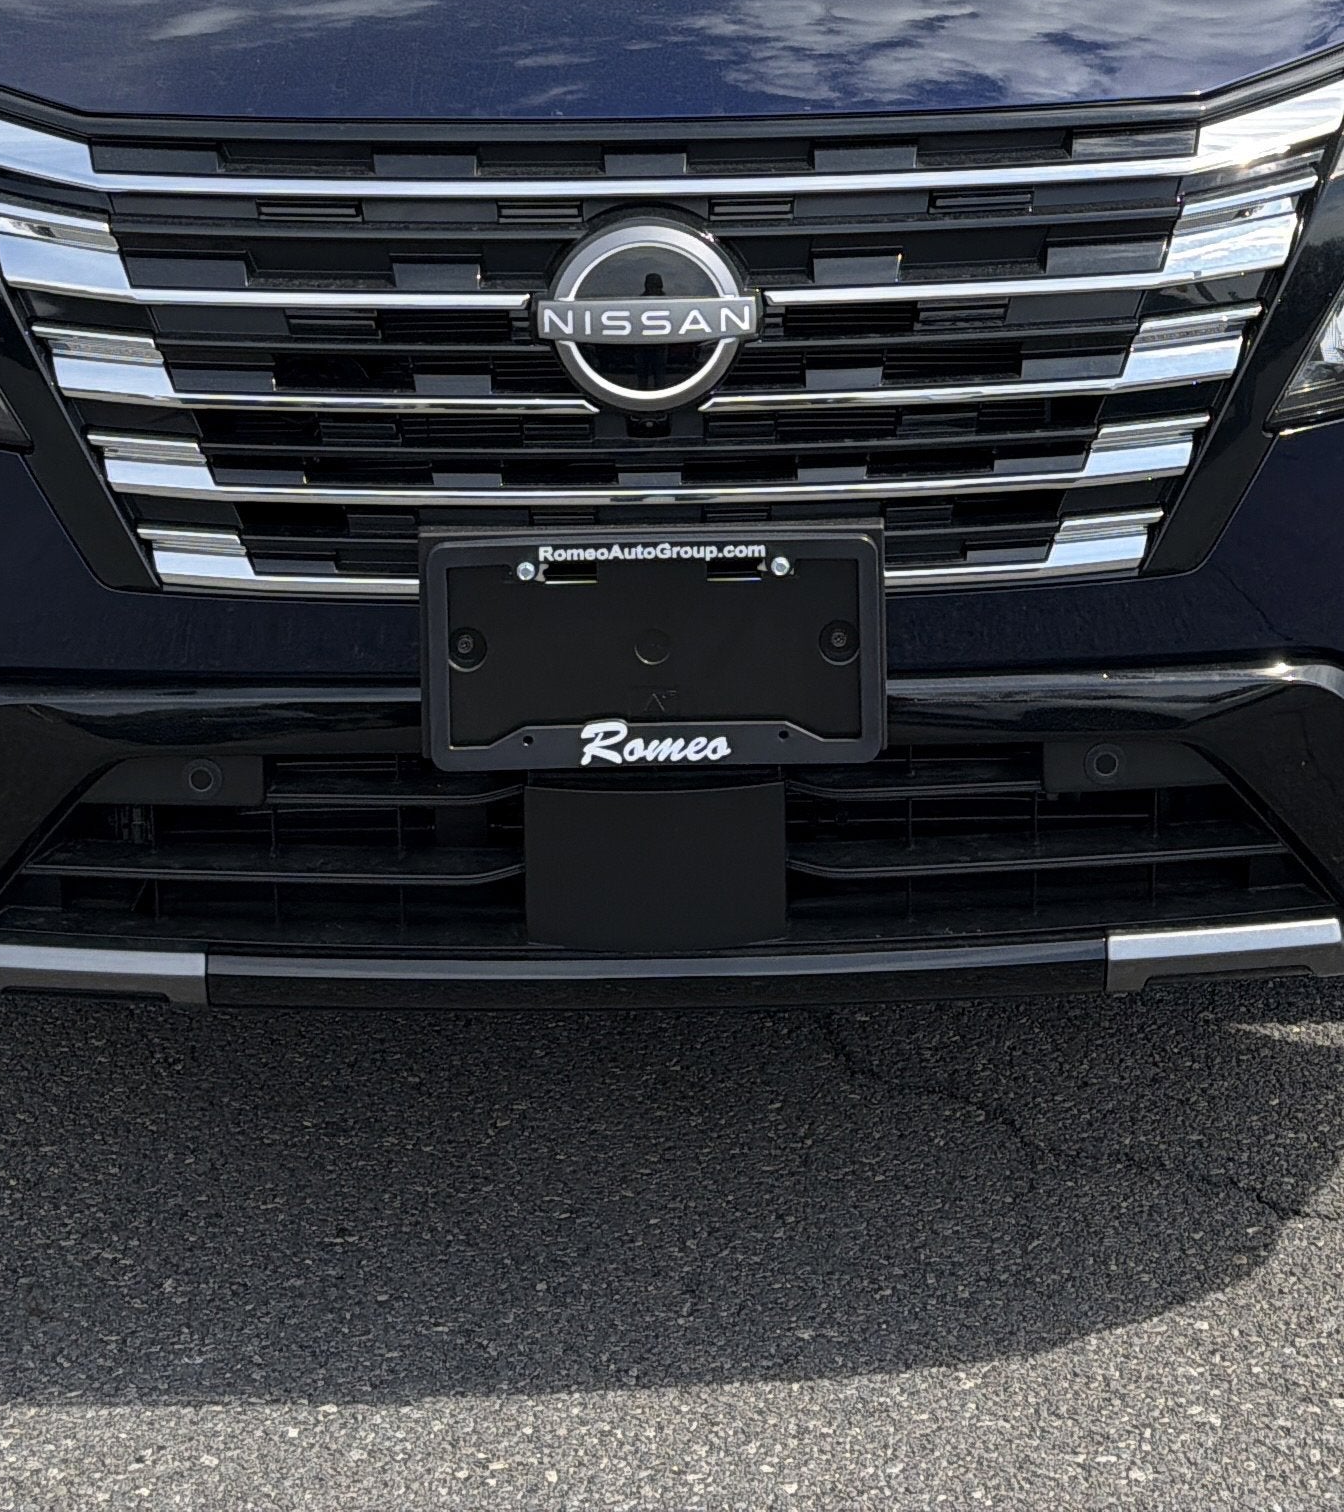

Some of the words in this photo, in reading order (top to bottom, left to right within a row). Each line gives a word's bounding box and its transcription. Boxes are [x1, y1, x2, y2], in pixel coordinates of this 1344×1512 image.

[543, 306, 751, 336] NISSAN
[538, 542, 767, 562] RomeoAutoGroup.com
[580, 721, 732, 766] Romeo
